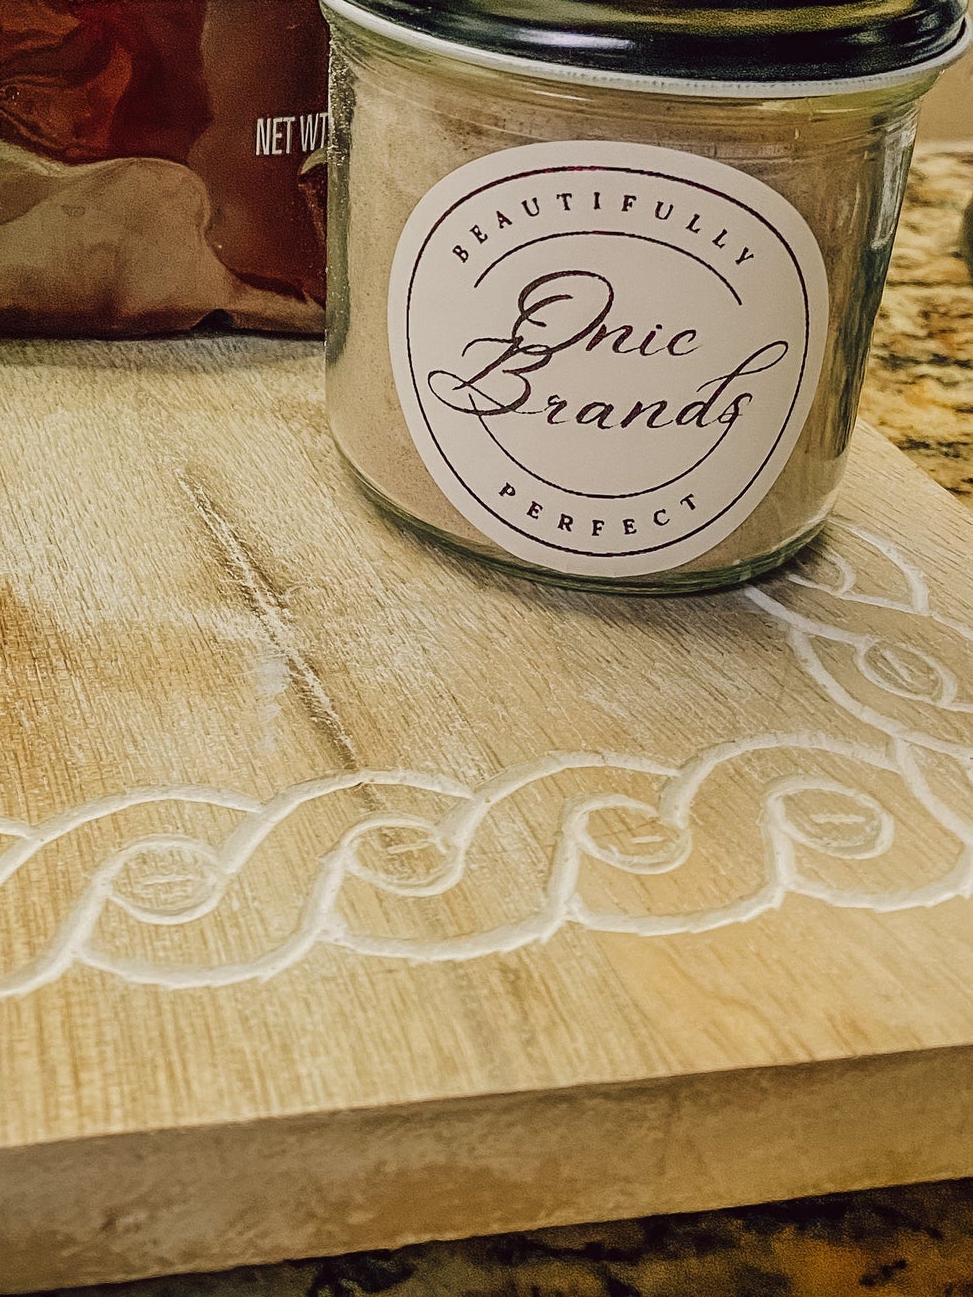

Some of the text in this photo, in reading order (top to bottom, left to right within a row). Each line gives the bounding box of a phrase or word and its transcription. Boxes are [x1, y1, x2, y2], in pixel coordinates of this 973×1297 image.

[255, 117, 296, 156] NET
[452, 192, 754, 266] BEAUTIFULLY
[428, 336, 789, 429] Brands
[498, 482, 698, 536] PERFECT
